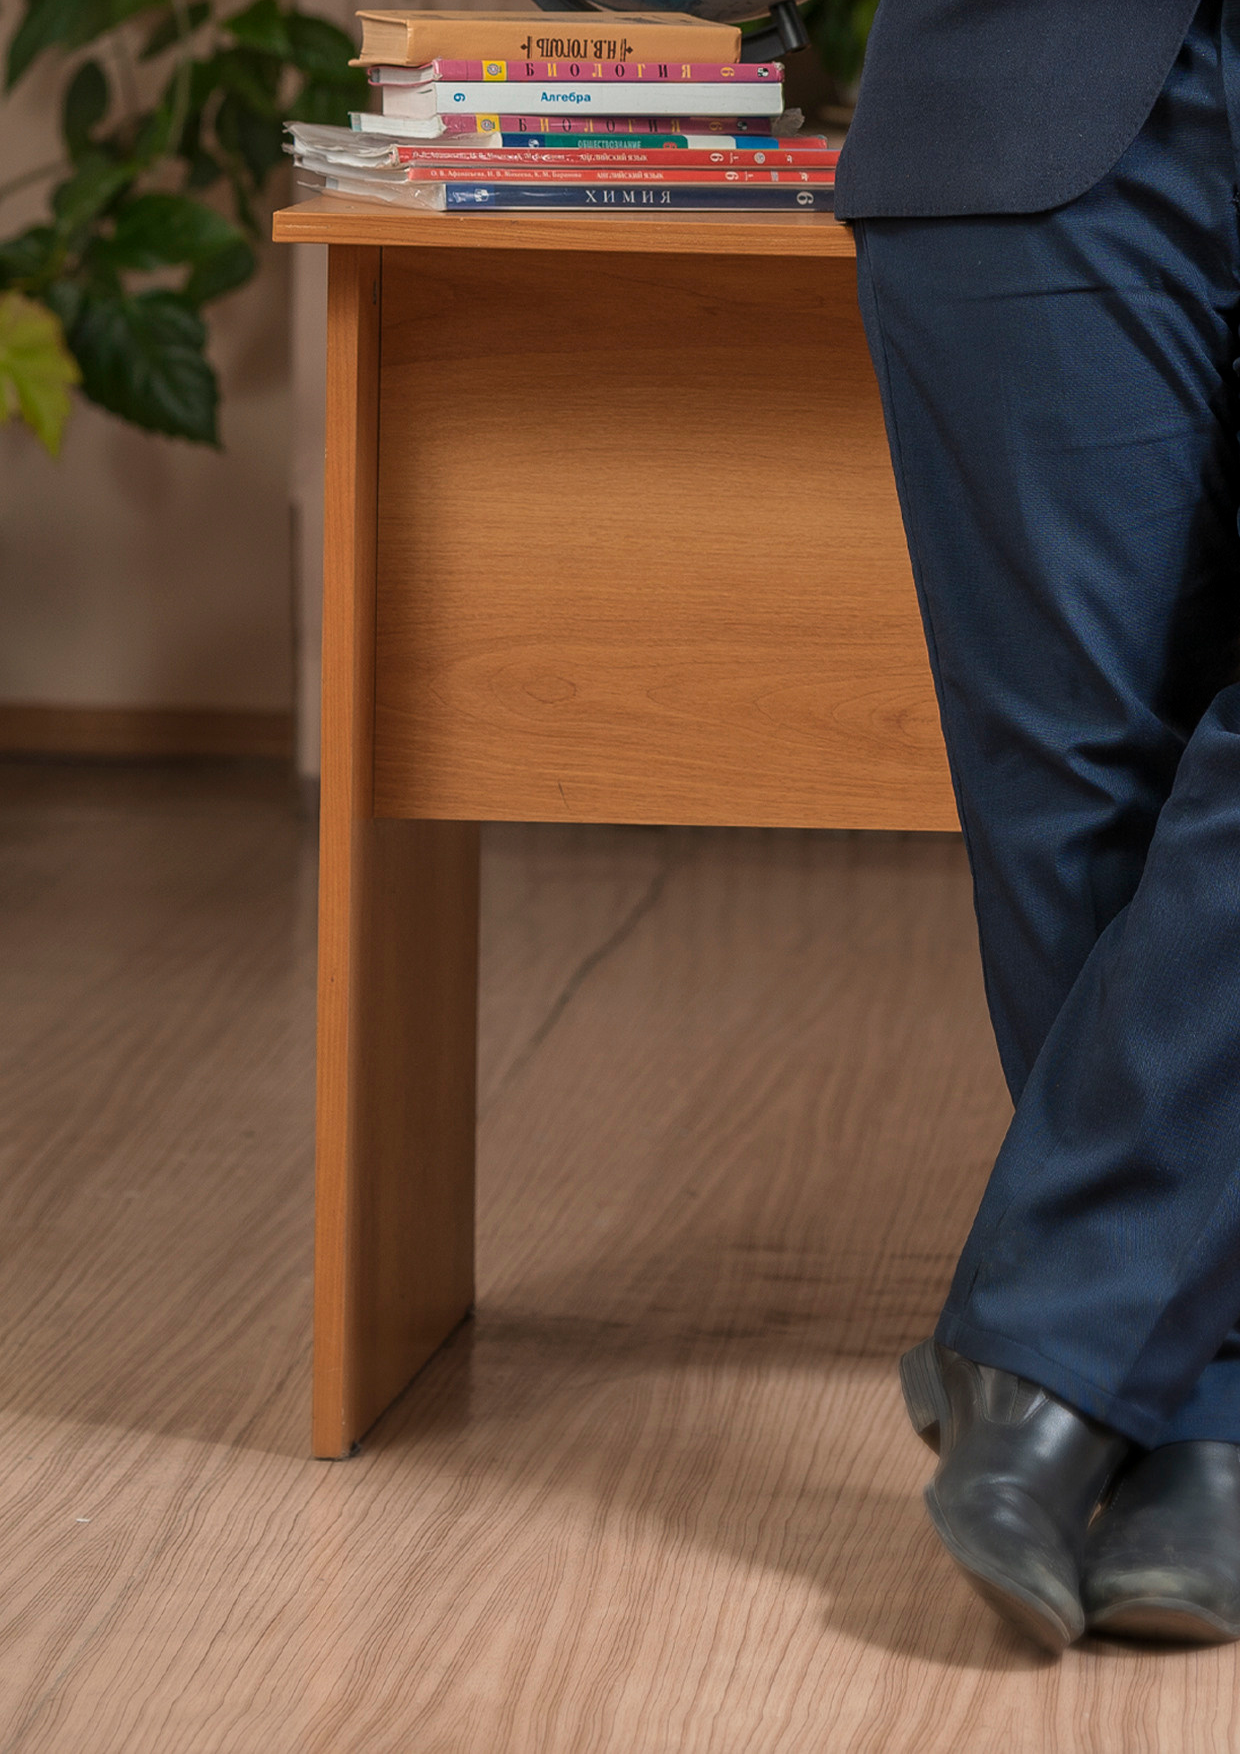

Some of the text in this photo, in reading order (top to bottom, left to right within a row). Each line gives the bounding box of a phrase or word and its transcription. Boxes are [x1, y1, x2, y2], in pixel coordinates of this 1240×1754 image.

[526, 63, 691, 78] БИОЛОГИЯ
[540, 91, 592, 104] Алгебра
[519, 117, 681, 132] БИОЛОГИЯ
[709, 152, 724, 163] 9
[725, 170, 740, 181] 9
[585, 190, 671, 204] ХИМИЯ
[796, 191, 815, 205] 9
